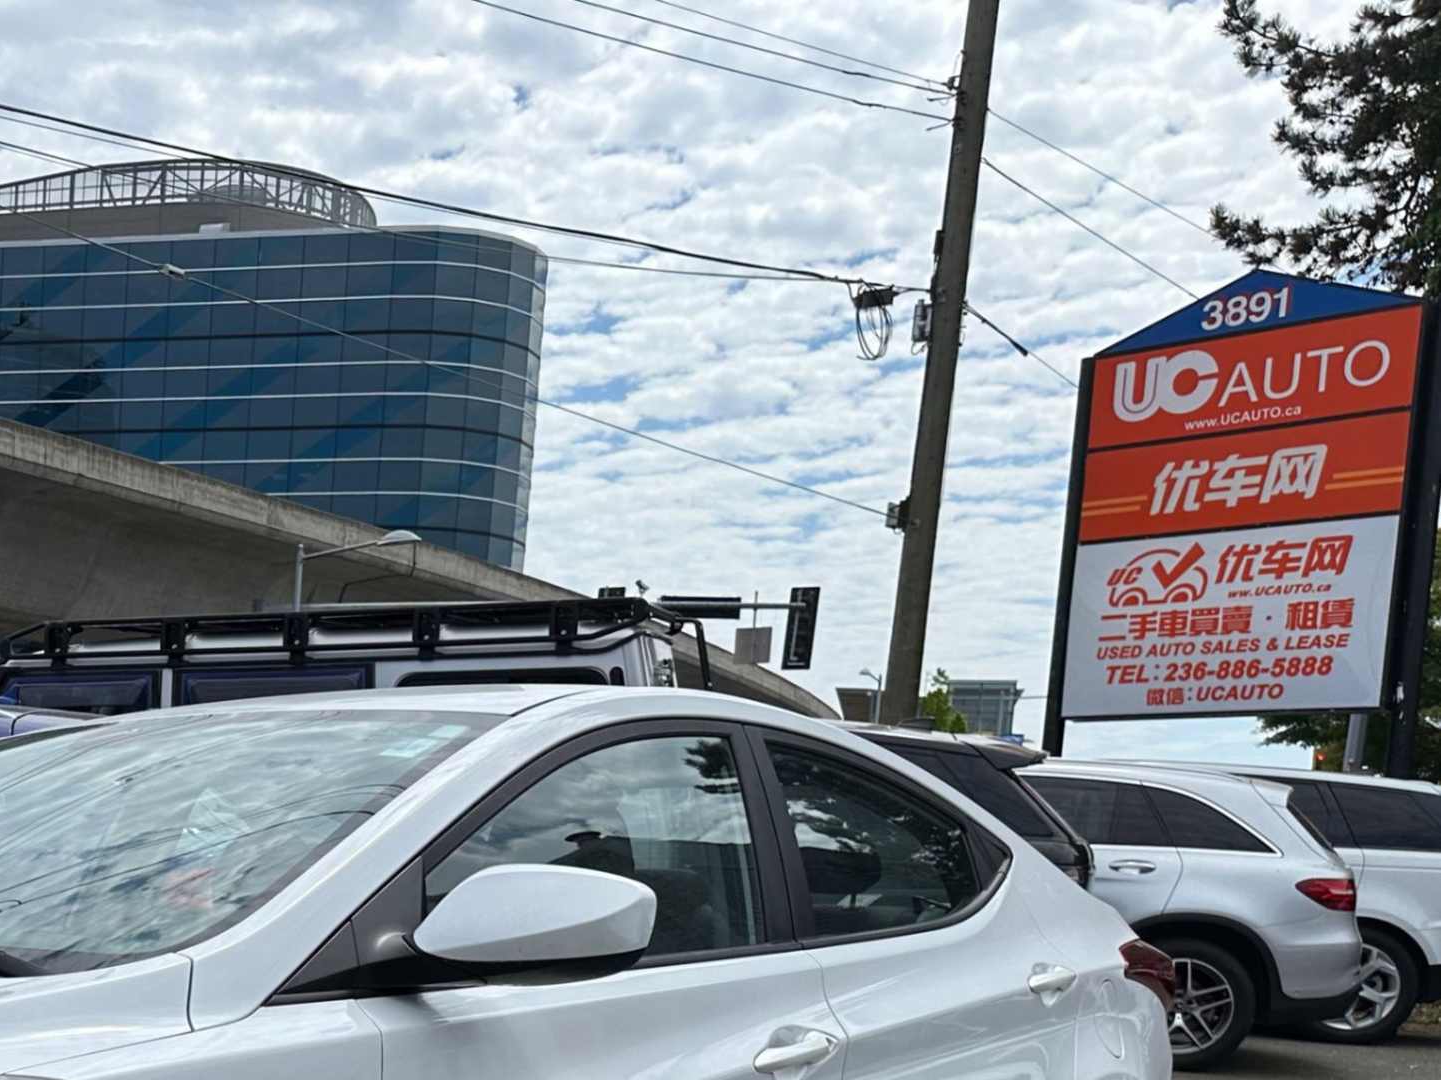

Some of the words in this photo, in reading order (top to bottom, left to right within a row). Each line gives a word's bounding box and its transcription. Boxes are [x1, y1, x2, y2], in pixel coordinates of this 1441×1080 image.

[1201, 287, 1290, 331] 3891
[1184, 404, 1302, 431] www.UCAUTO.ca
[1149, 443, 1328, 516] 优车网
[1106, 566, 1143, 587] UC
[1215, 535, 1354, 585] 优车网
[1096, 644, 1142, 661] USED
[1146, 641, 1196, 659] AUTO
[1200, 637, 1261, 656] SALES
[1266, 637, 1279, 652] &
[1284, 633, 1351, 651] LEASE
